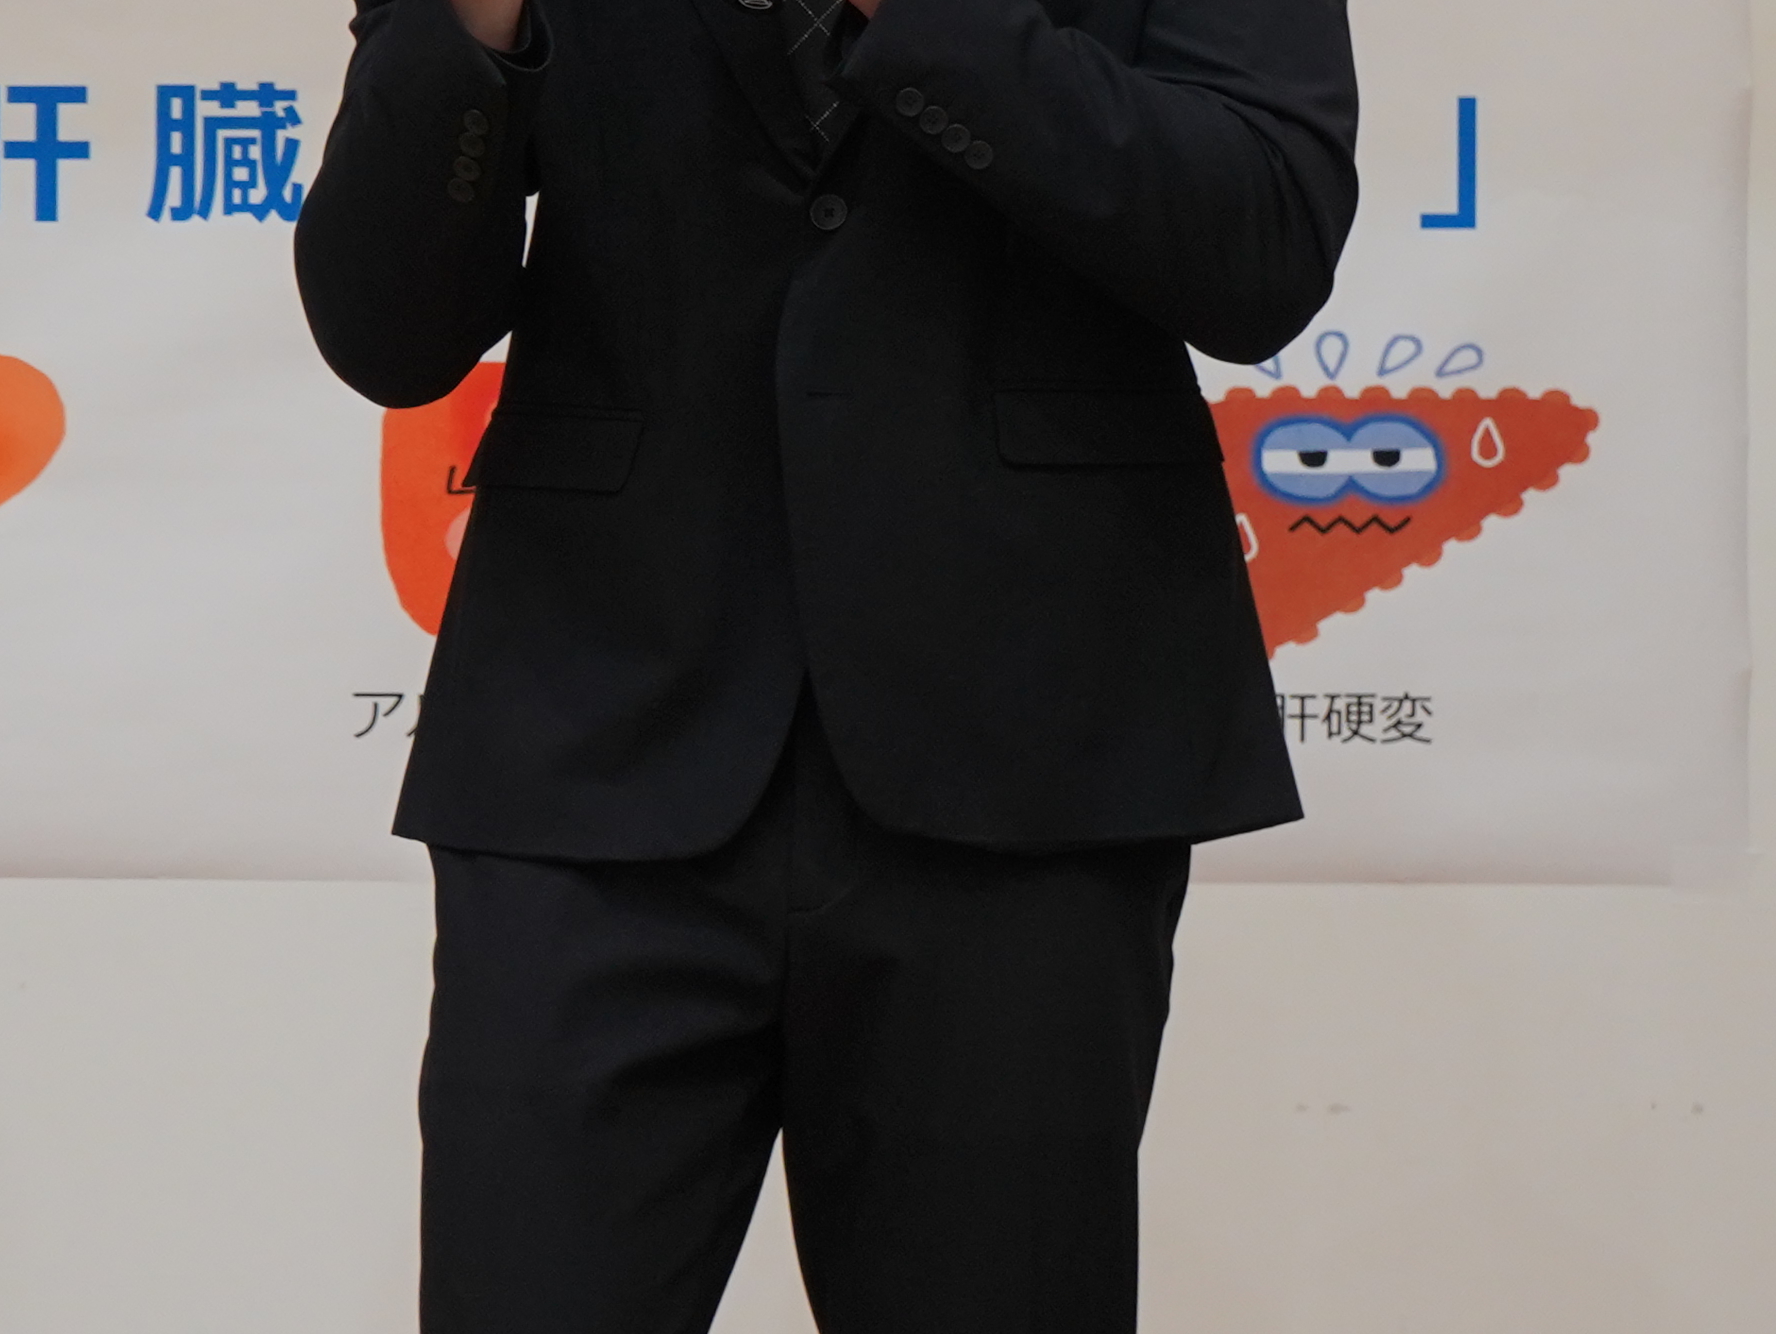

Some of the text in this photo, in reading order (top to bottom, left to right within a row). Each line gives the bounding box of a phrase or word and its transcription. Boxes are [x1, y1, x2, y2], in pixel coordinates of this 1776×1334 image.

[351, 691, 425, 738] ア
[1275, 691, 1433, 746] 肝硬変
